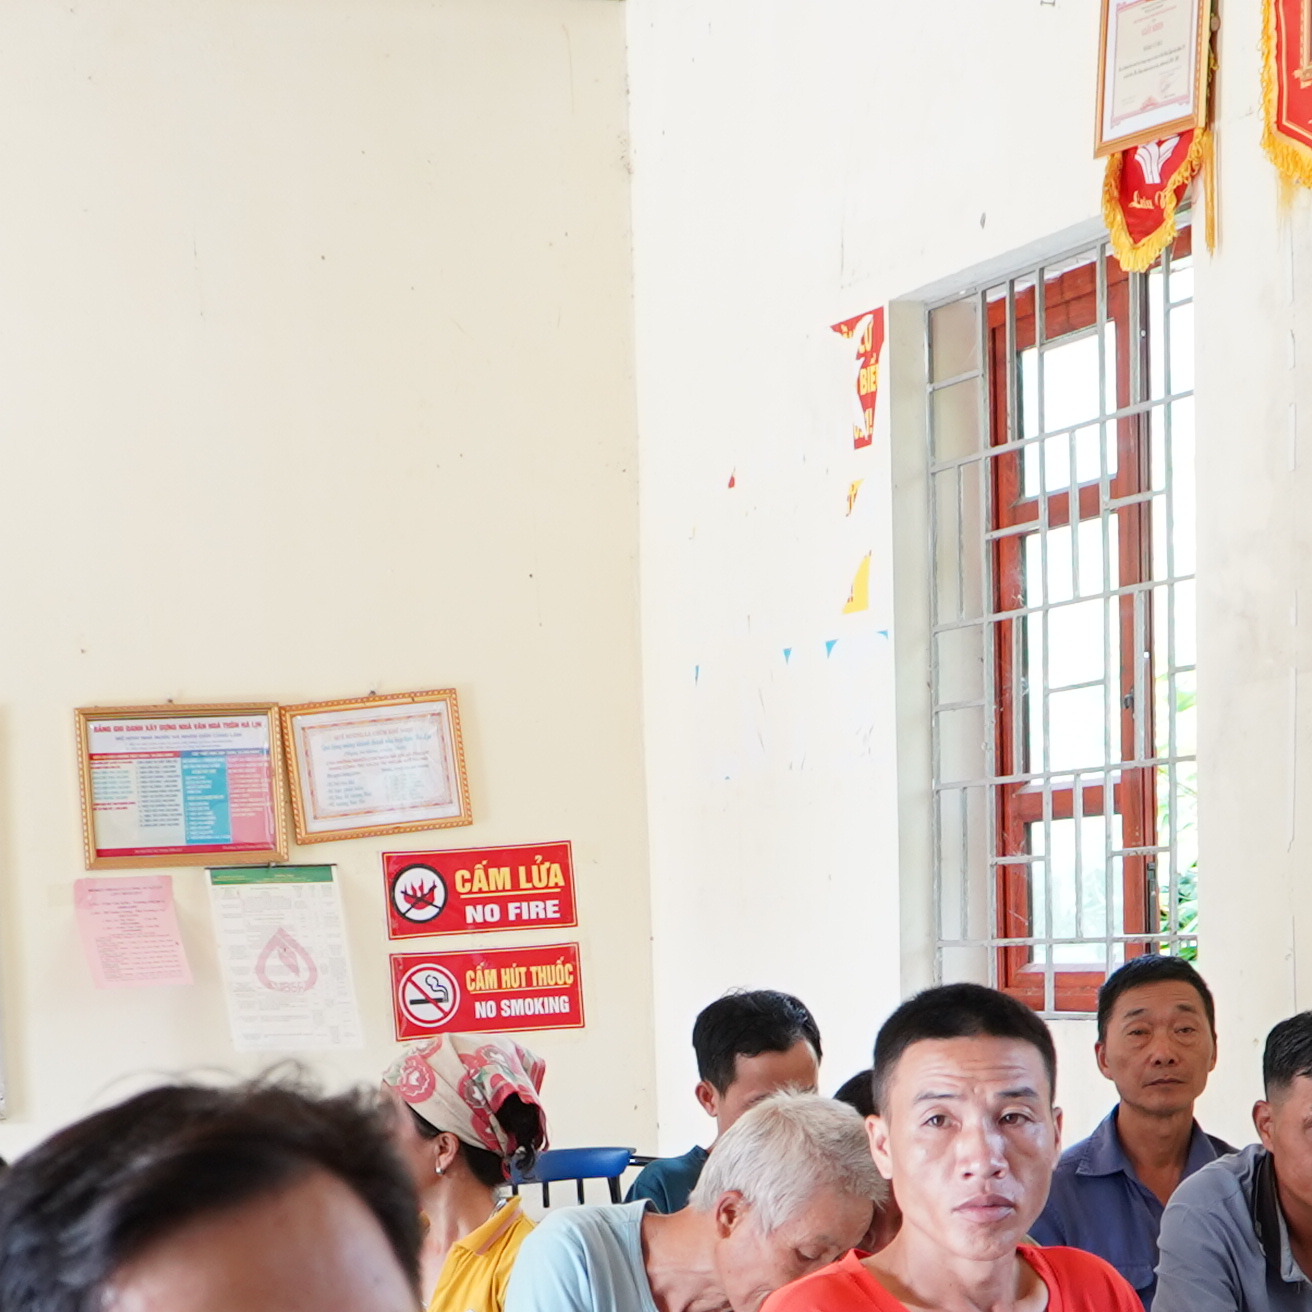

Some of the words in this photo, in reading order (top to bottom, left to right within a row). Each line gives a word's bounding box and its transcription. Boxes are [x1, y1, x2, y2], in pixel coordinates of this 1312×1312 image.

[455, 860, 512, 893] CẤM
[518, 855, 566, 889] LỬA
[465, 903, 501, 924] NO
[507, 900, 561, 921] FIRE
[465, 962, 498, 991] CẤM
[501, 963, 527, 989] HÚT
[529, 957, 574, 987] THUỐC
[474, 1000, 497, 1019] NO
[500, 995, 570, 1017] SMOKING
